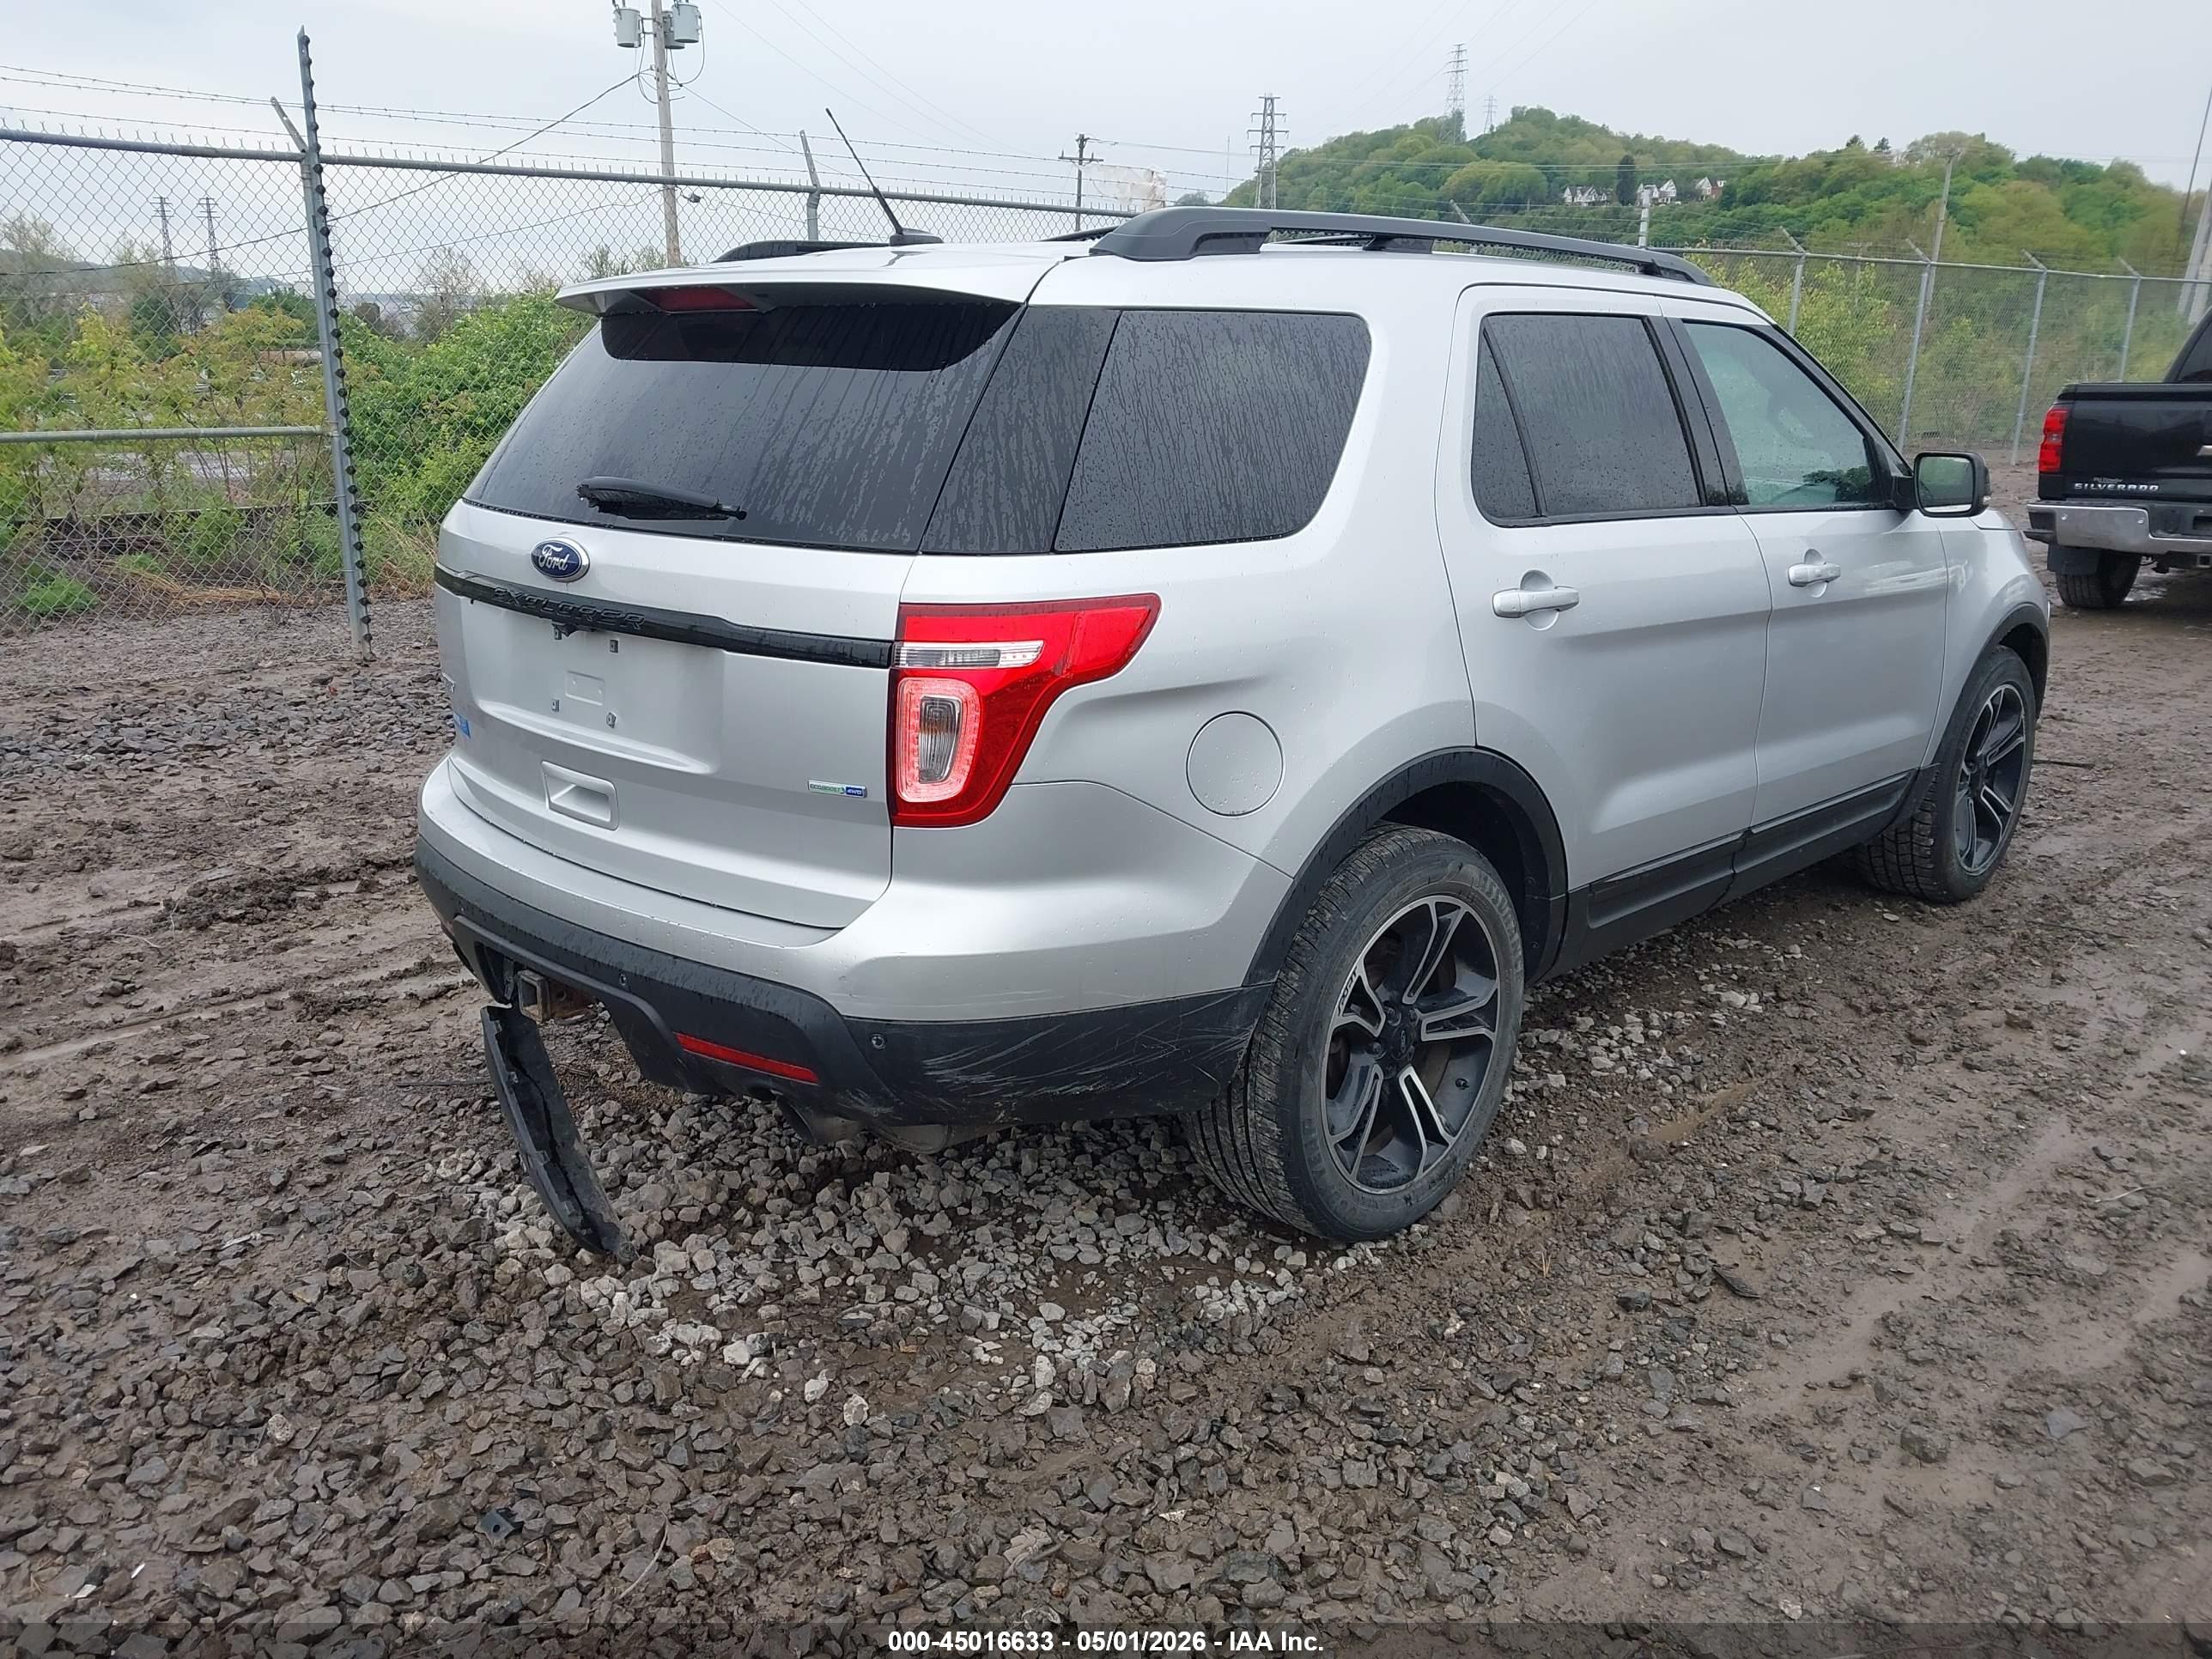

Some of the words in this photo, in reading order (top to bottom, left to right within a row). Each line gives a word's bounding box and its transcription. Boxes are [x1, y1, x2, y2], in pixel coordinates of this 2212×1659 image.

[2074, 483, 2159, 492] SILVERADO
[538, 544, 570, 571] Ford
[494, 586, 646, 630] EXPLORER
[1336, 964, 1358, 1018] SPORT
